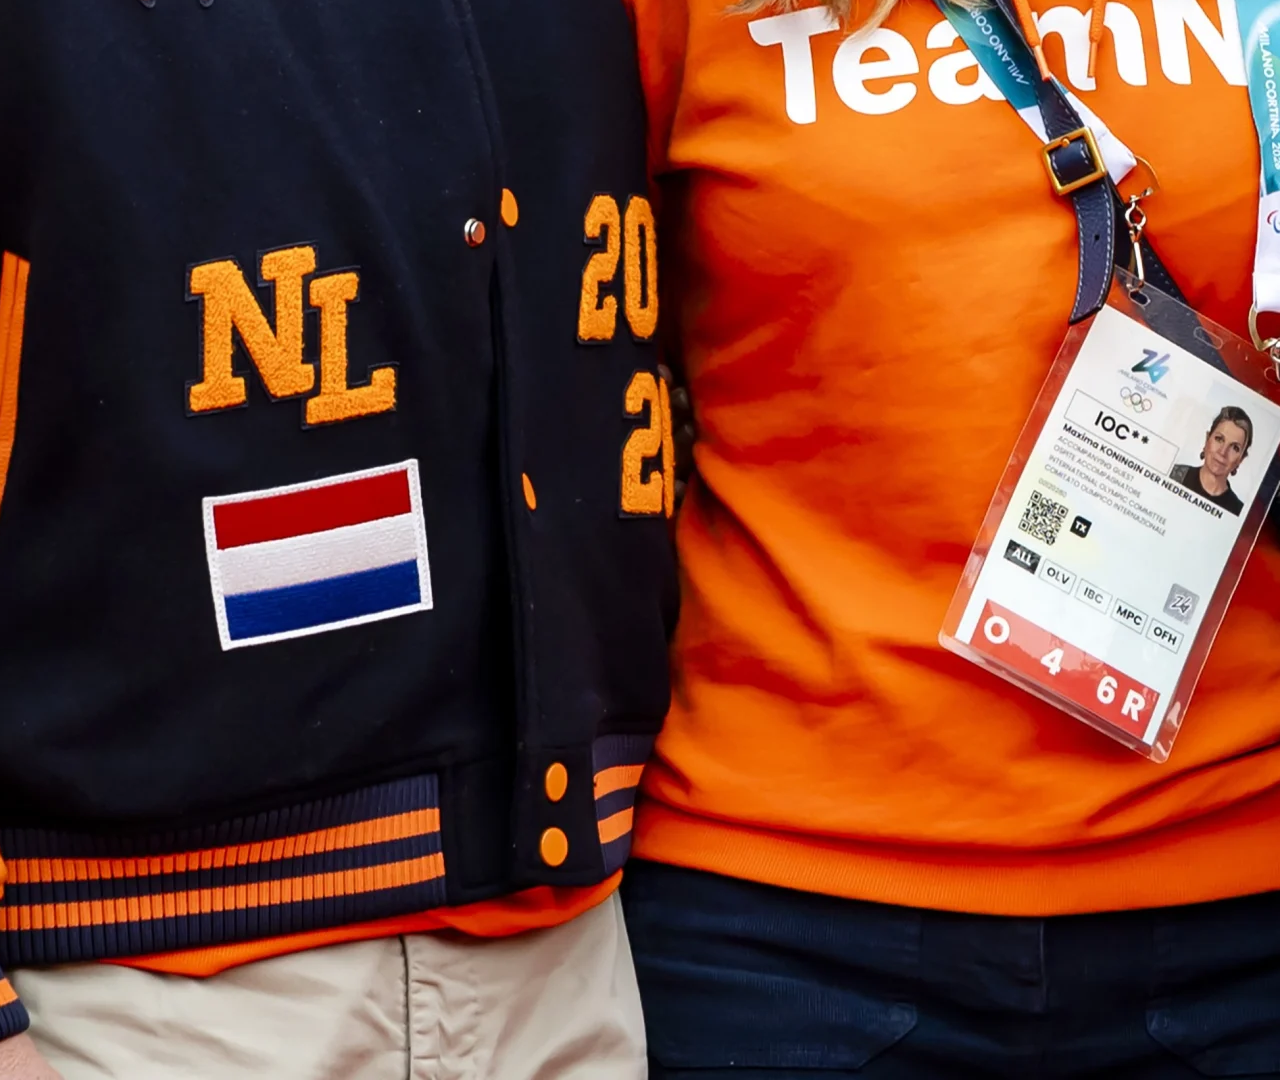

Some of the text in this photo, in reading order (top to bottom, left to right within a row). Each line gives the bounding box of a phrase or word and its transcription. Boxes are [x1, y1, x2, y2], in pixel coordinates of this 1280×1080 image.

[989, 35, 1030, 85] MILANO
[1257, 21, 1274, 78] MILANO
[1265, 78, 1280, 139] CORTINA
[578, 195, 659, 340] 20
[189, 246, 396, 424] NL
[1056, 434, 1134, 482] ACCOMPANYING GUEST
[1062, 422, 1223, 519] Maxima KONINGIN DER NEDERLANDEN
[1047, 453, 1099, 487] INTERNATIONAL
[1098, 482, 1129, 504] OLYMPIC
[1127, 498, 1168, 526] COMMITTEE
[1074, 520, 1088, 533] TX
[1011, 547, 1177, 646] ALL OLV IBC MPC OFH
[1040, 647, 1064, 676] 4
